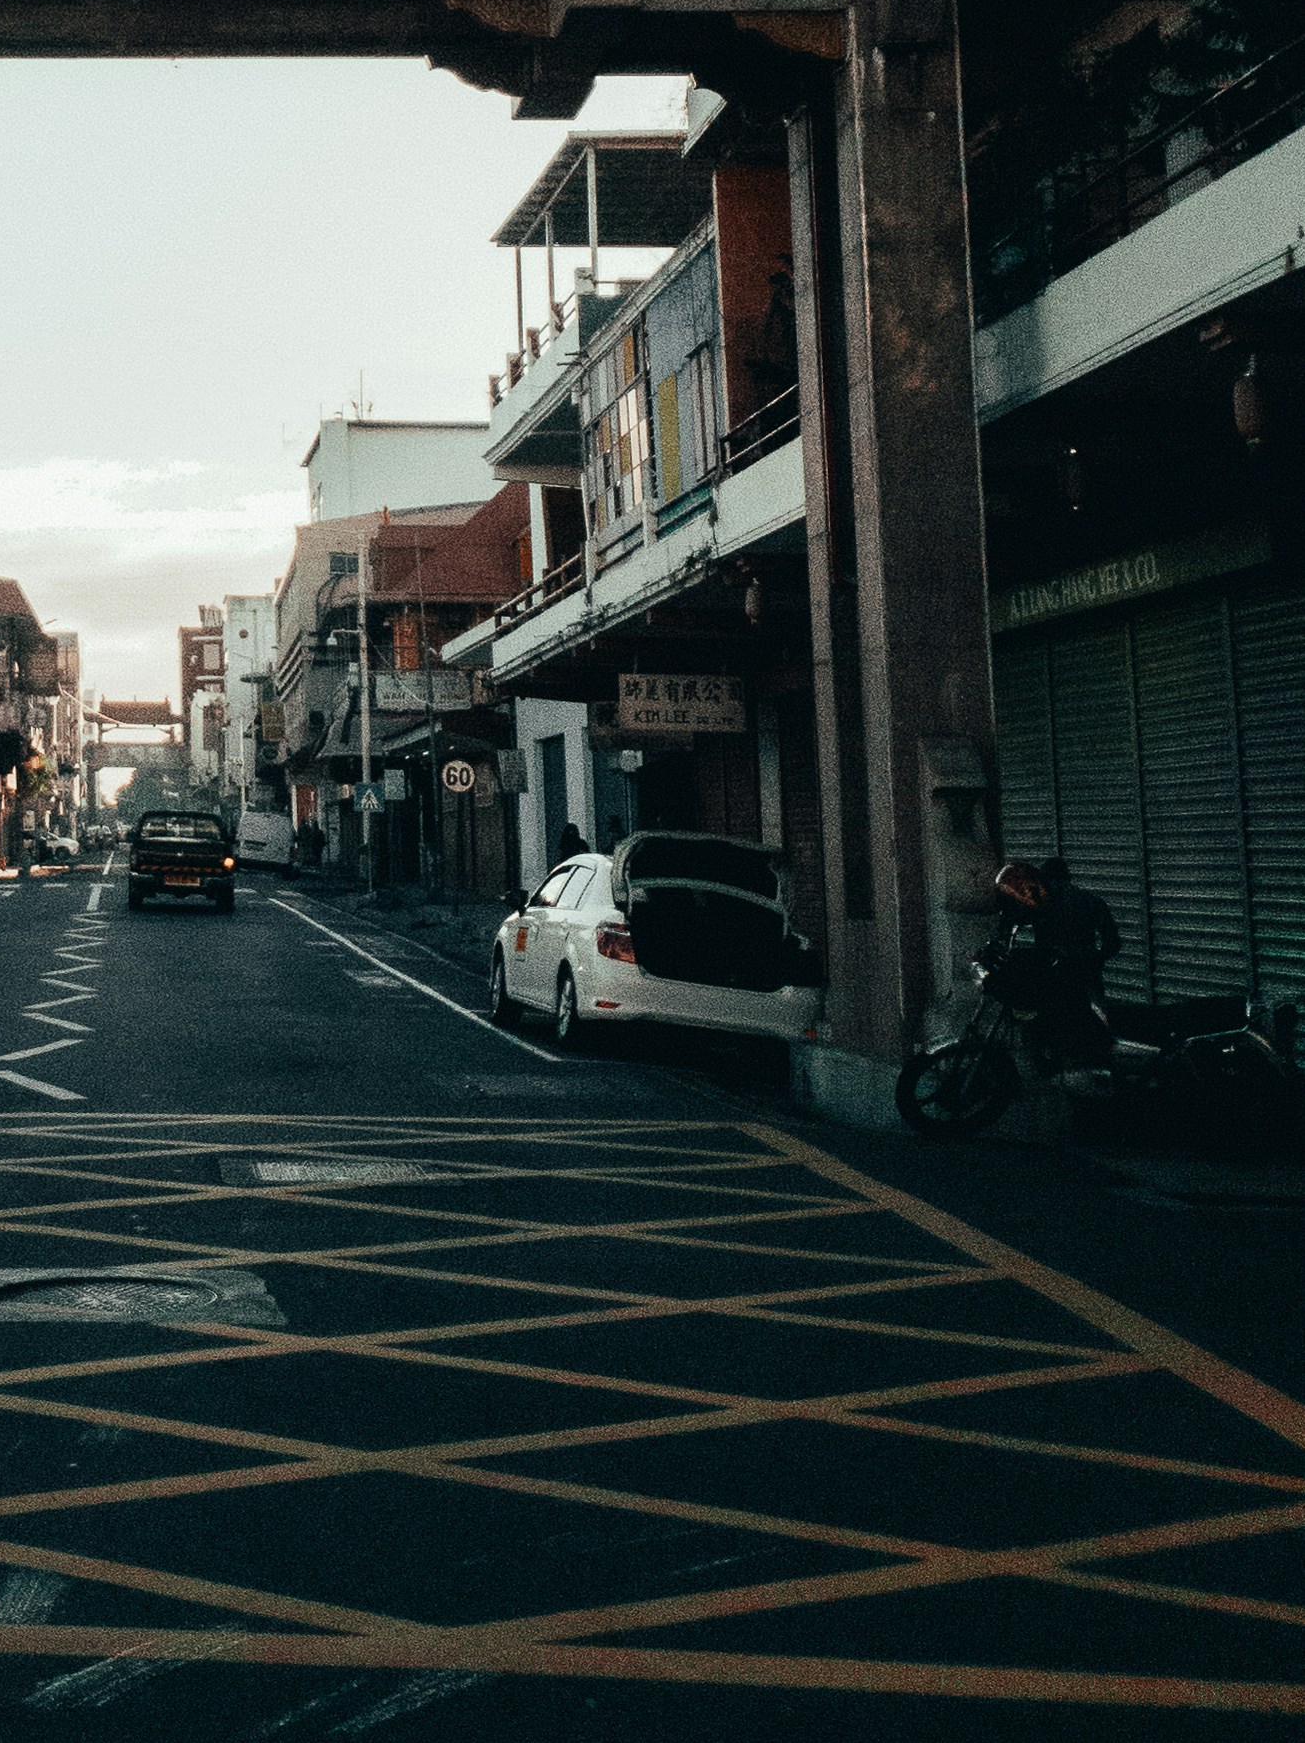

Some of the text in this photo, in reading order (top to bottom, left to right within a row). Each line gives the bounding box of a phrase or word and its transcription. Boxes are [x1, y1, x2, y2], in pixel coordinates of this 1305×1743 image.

[634, 710, 661, 724] KIM
[664, 710, 691, 724] LEE
[445, 765, 472, 787] 60
